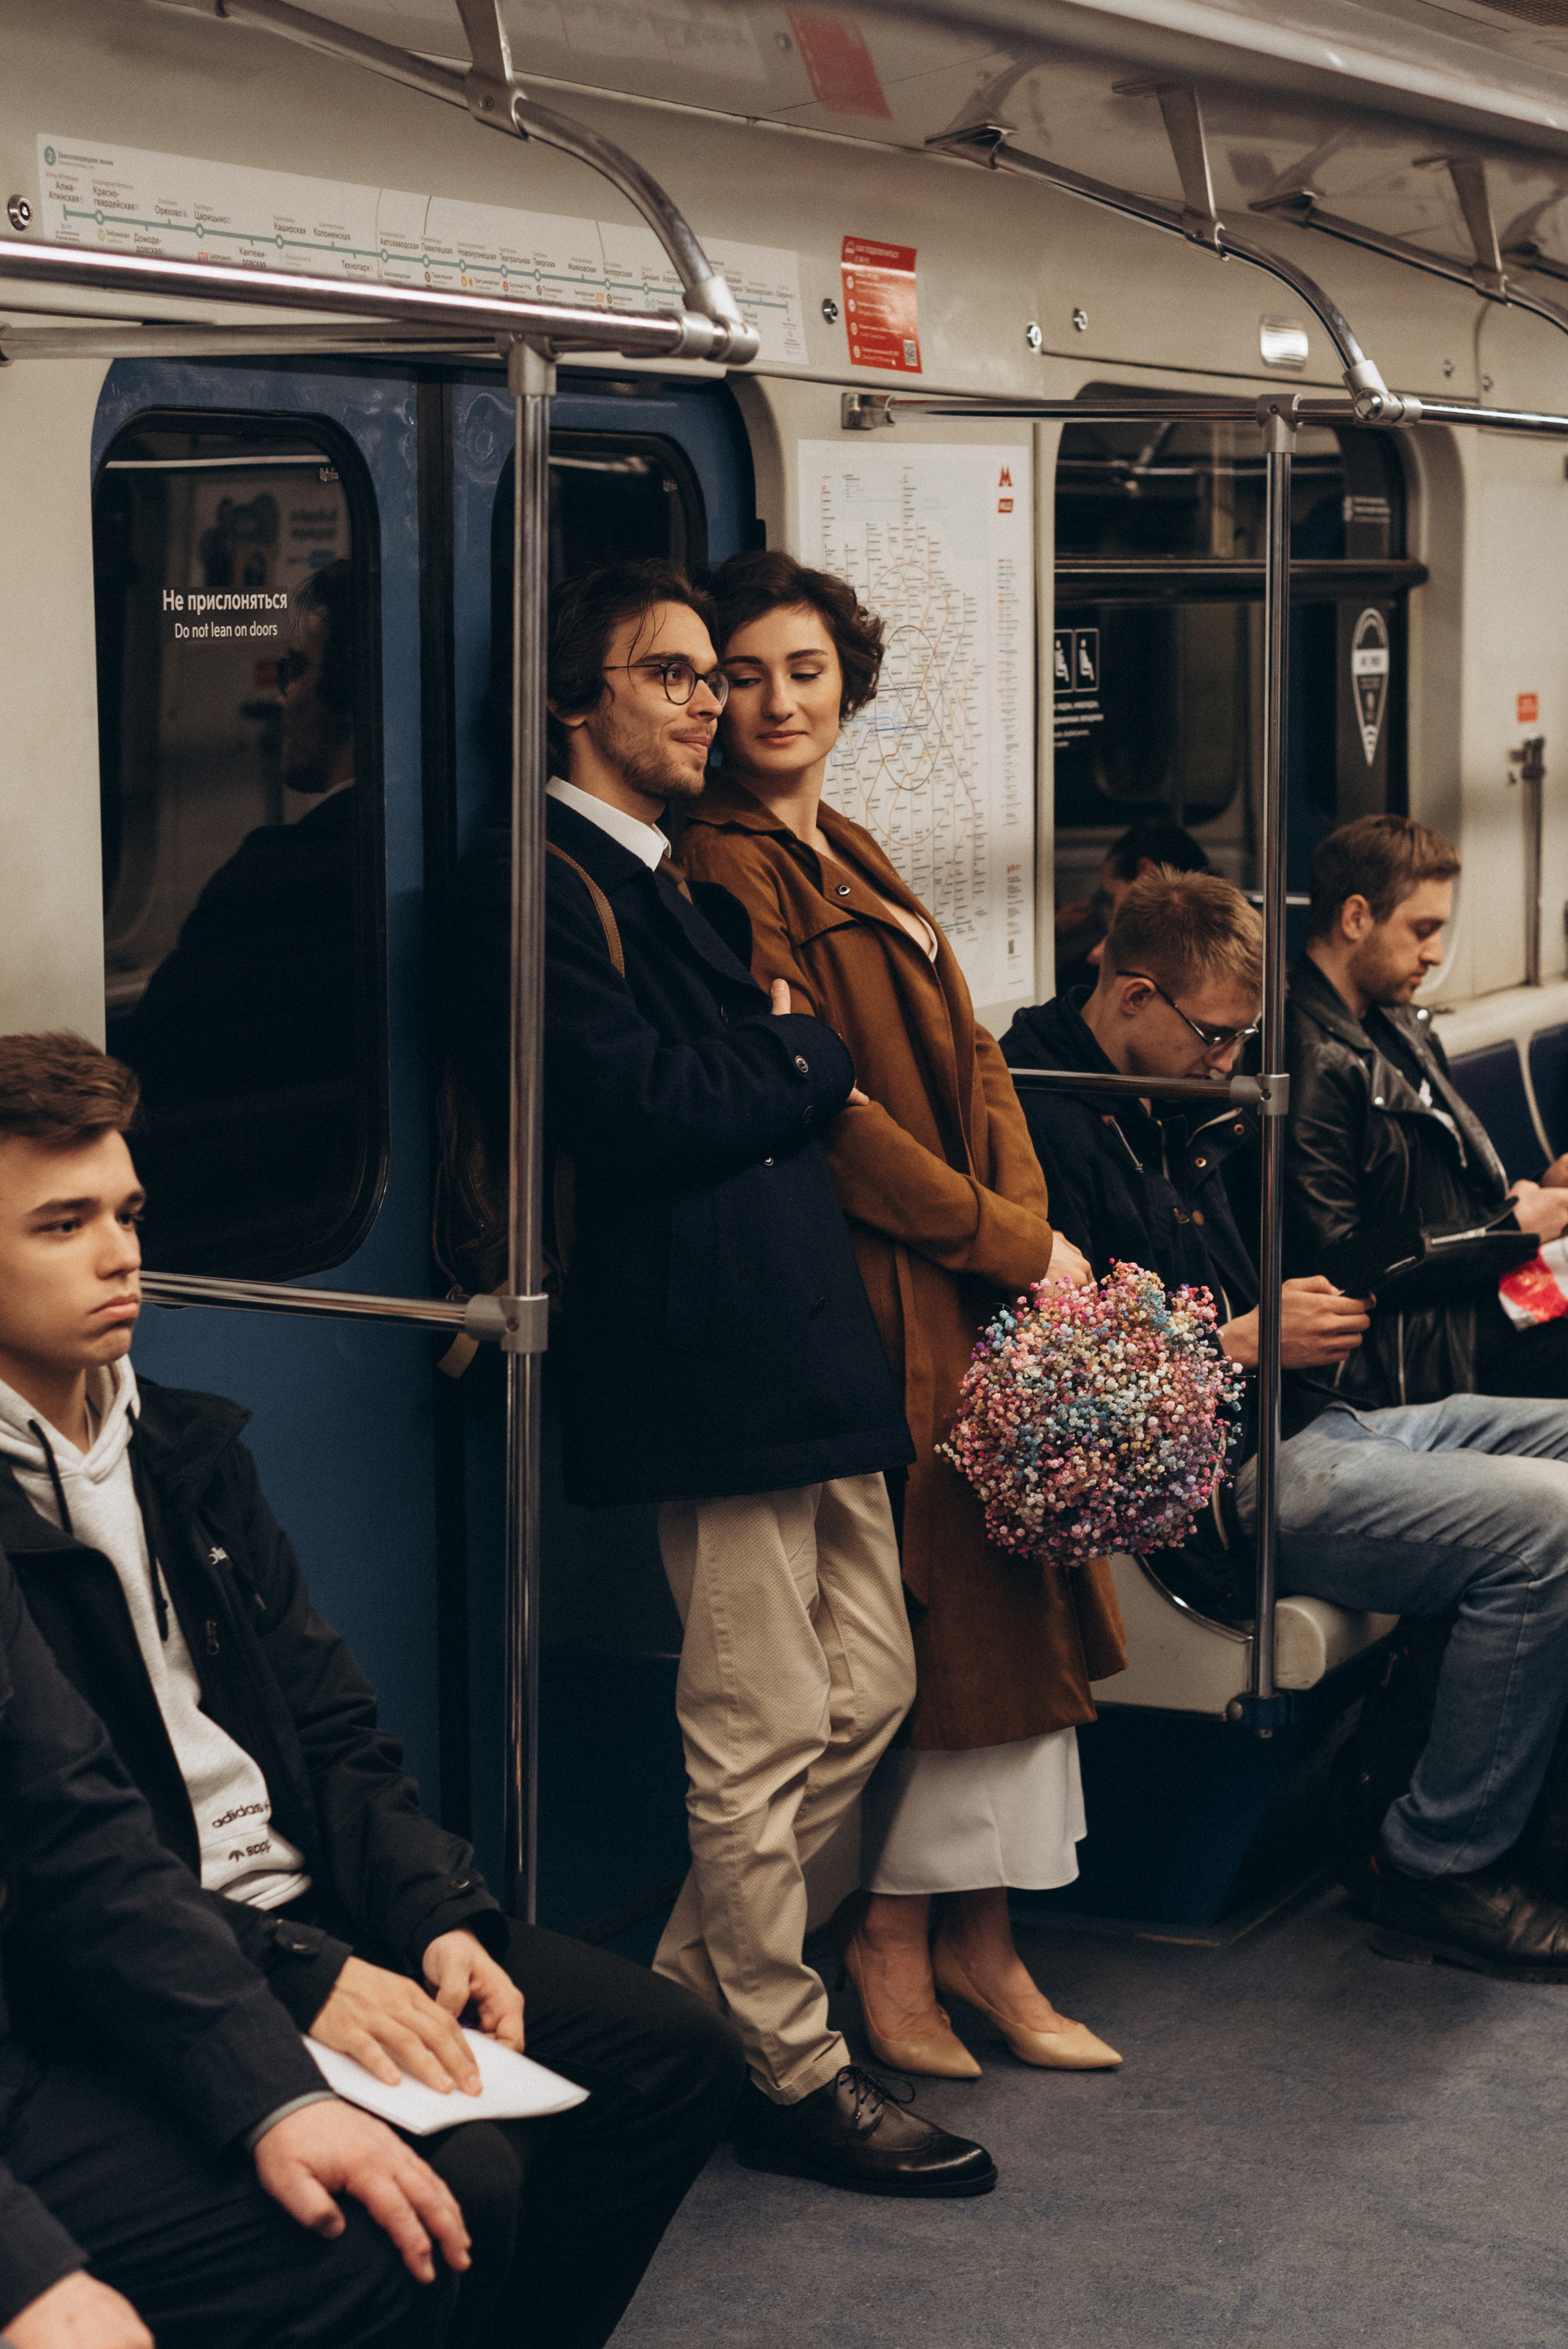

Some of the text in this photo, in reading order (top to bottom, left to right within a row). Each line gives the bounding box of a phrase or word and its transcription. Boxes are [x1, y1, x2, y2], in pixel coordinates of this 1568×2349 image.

[56, 181, 76, 192] Алма-
[93, 186, 119, 198] Красно-
[48, 191, 80, 202] Атинская
[94, 198, 135, 210] гвардейская
[154, 205, 183, 218] Орехово
[194, 211, 227, 224] Царицыно
[274, 222, 306, 235] Каширская
[313, 227, 351, 241] Коломенская
[134, 232, 162, 246] Домоде-
[380, 237, 419, 250] Автозаводская
[136, 246, 162, 255] довская
[239, 246, 267, 258] Кантеми-
[421, 243, 453, 255] Павелецкая
[457, 248, 497, 260] Новокузнецкая
[242, 259, 267, 268] ровская
[499, 253, 530, 265] Театральная
[533, 257, 556, 268] Тверская
[341, 260, 371, 273] Технопарк
[163, 589, 287, 615] Не прислоняться
[175, 620, 278, 638] Do not lean on doors
[212, 1803, 263, 1828] adidas
